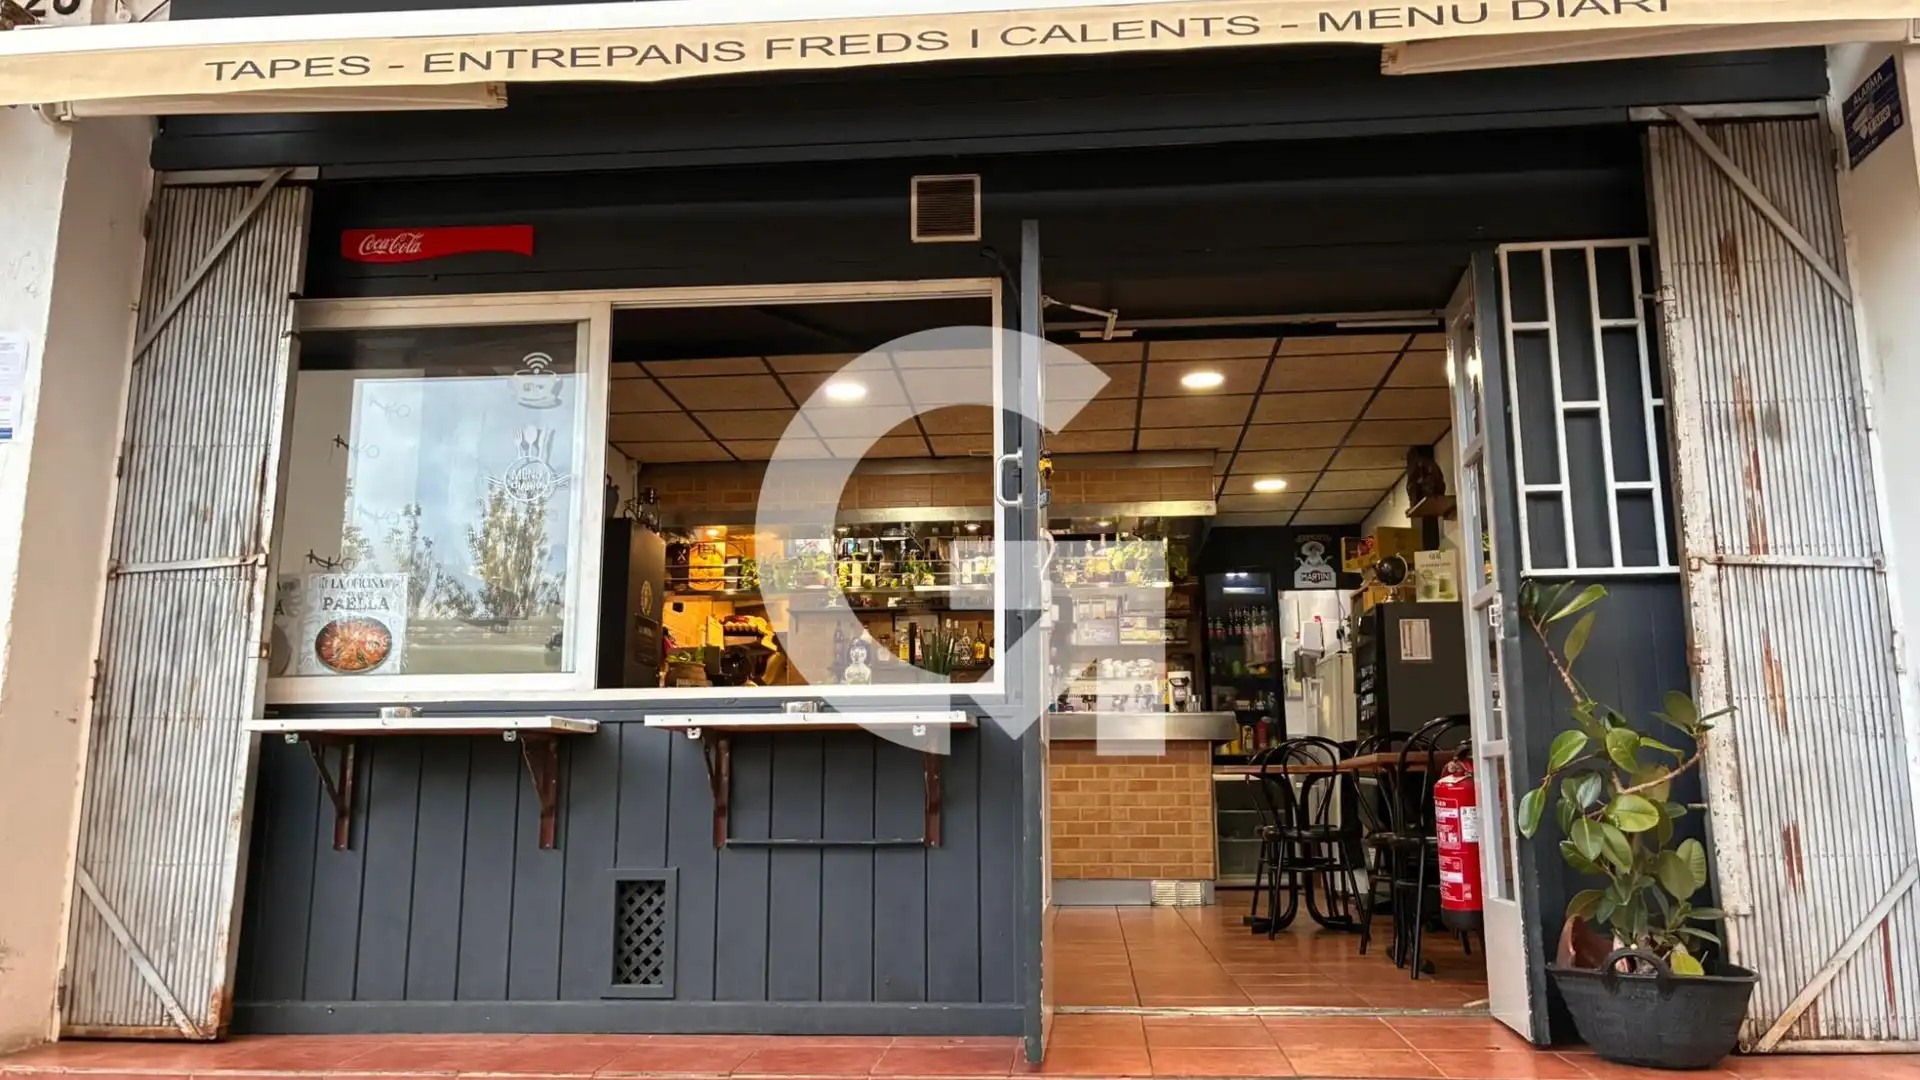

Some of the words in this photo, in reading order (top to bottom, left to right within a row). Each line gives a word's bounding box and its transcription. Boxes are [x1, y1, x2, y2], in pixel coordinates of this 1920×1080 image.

[205, 55, 371, 81] TAPES
[423, 40, 746, 73] ENTREPANS
[766, 30, 949, 59] FREDS
[971, 28, 979, 49] I
[1000, 15, 1261, 46] CALENTS
[1318, 2, 1488, 32] MENU
[1512, 0, 1668, 21] DIARI
[322, 595, 390, 611] PAELLA
